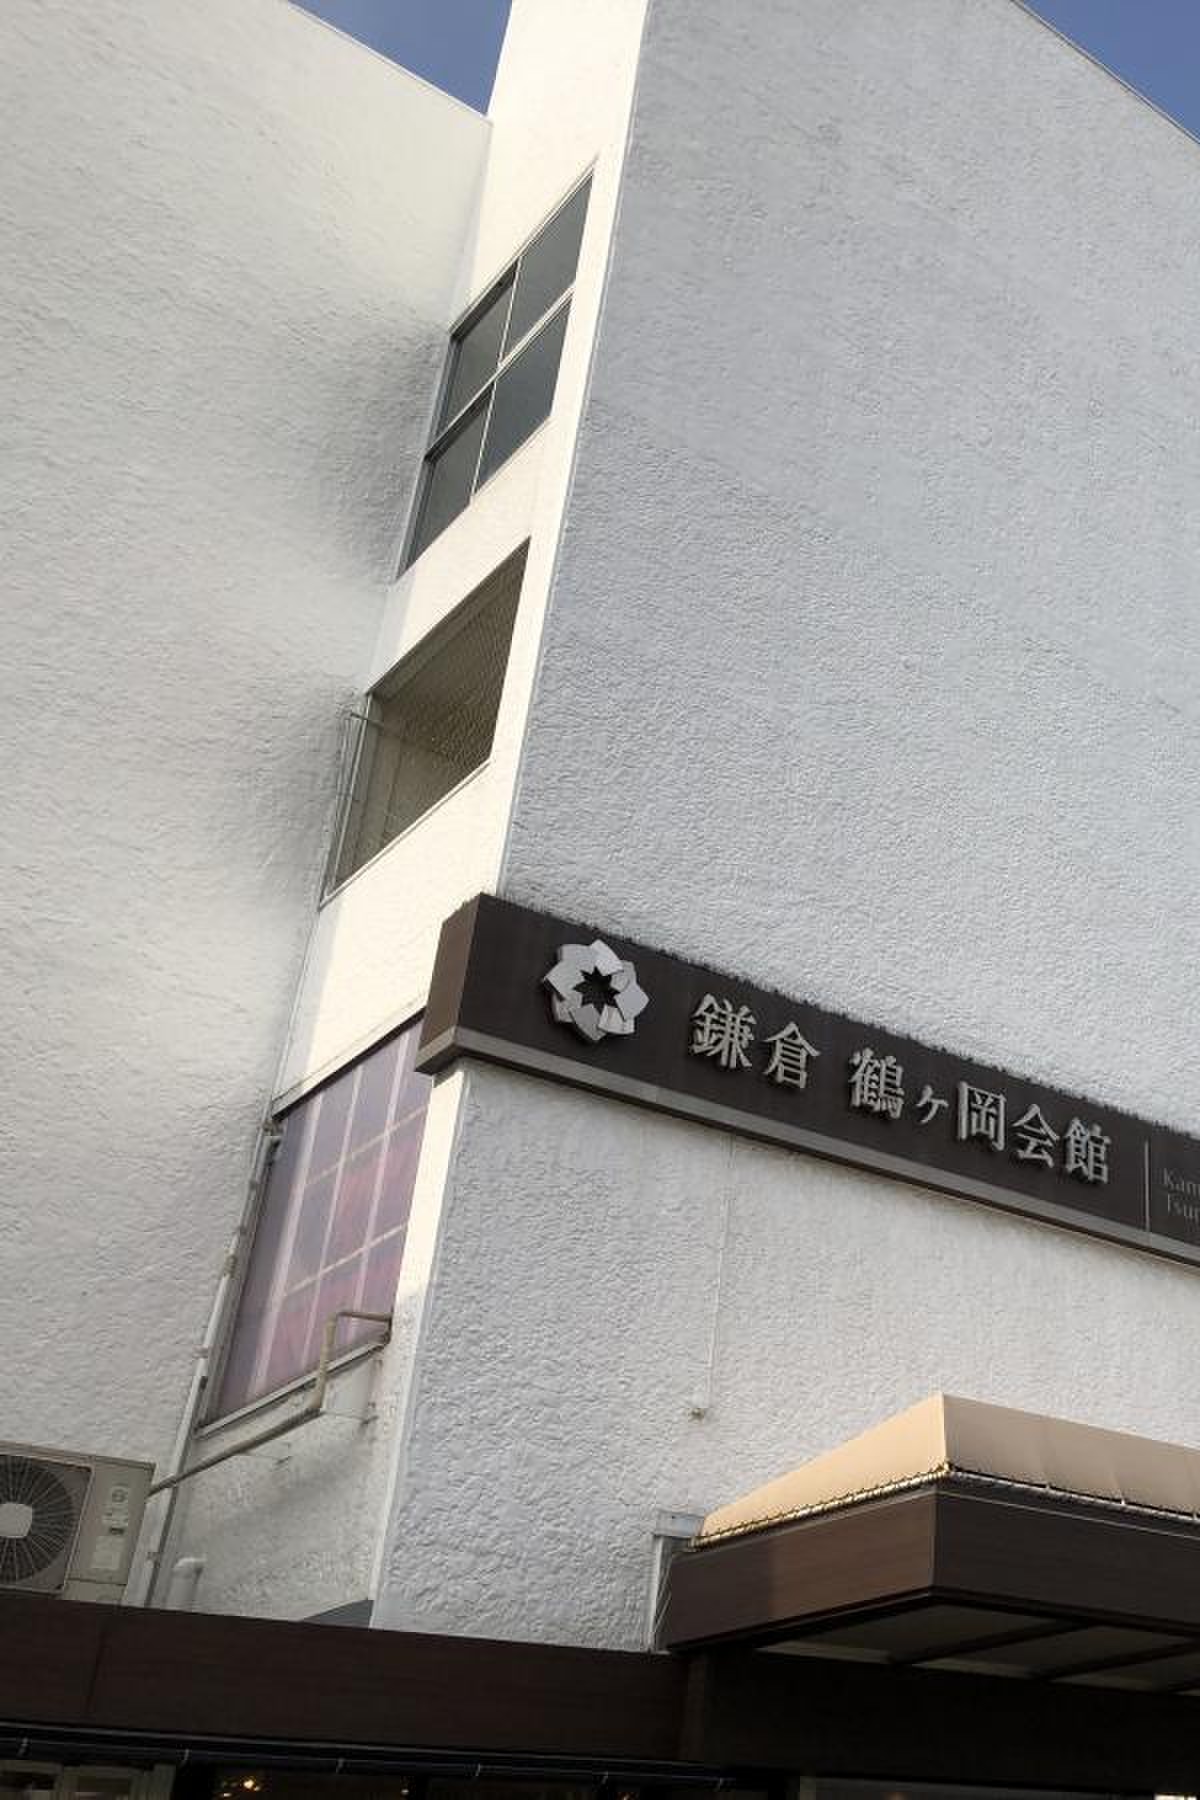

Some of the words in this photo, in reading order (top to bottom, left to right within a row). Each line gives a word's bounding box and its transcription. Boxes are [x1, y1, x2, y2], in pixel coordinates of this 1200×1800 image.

[689, 992, 821, 1089] 鎌倉
[847, 1046, 1111, 1185] 鶴ヶ岡会館
